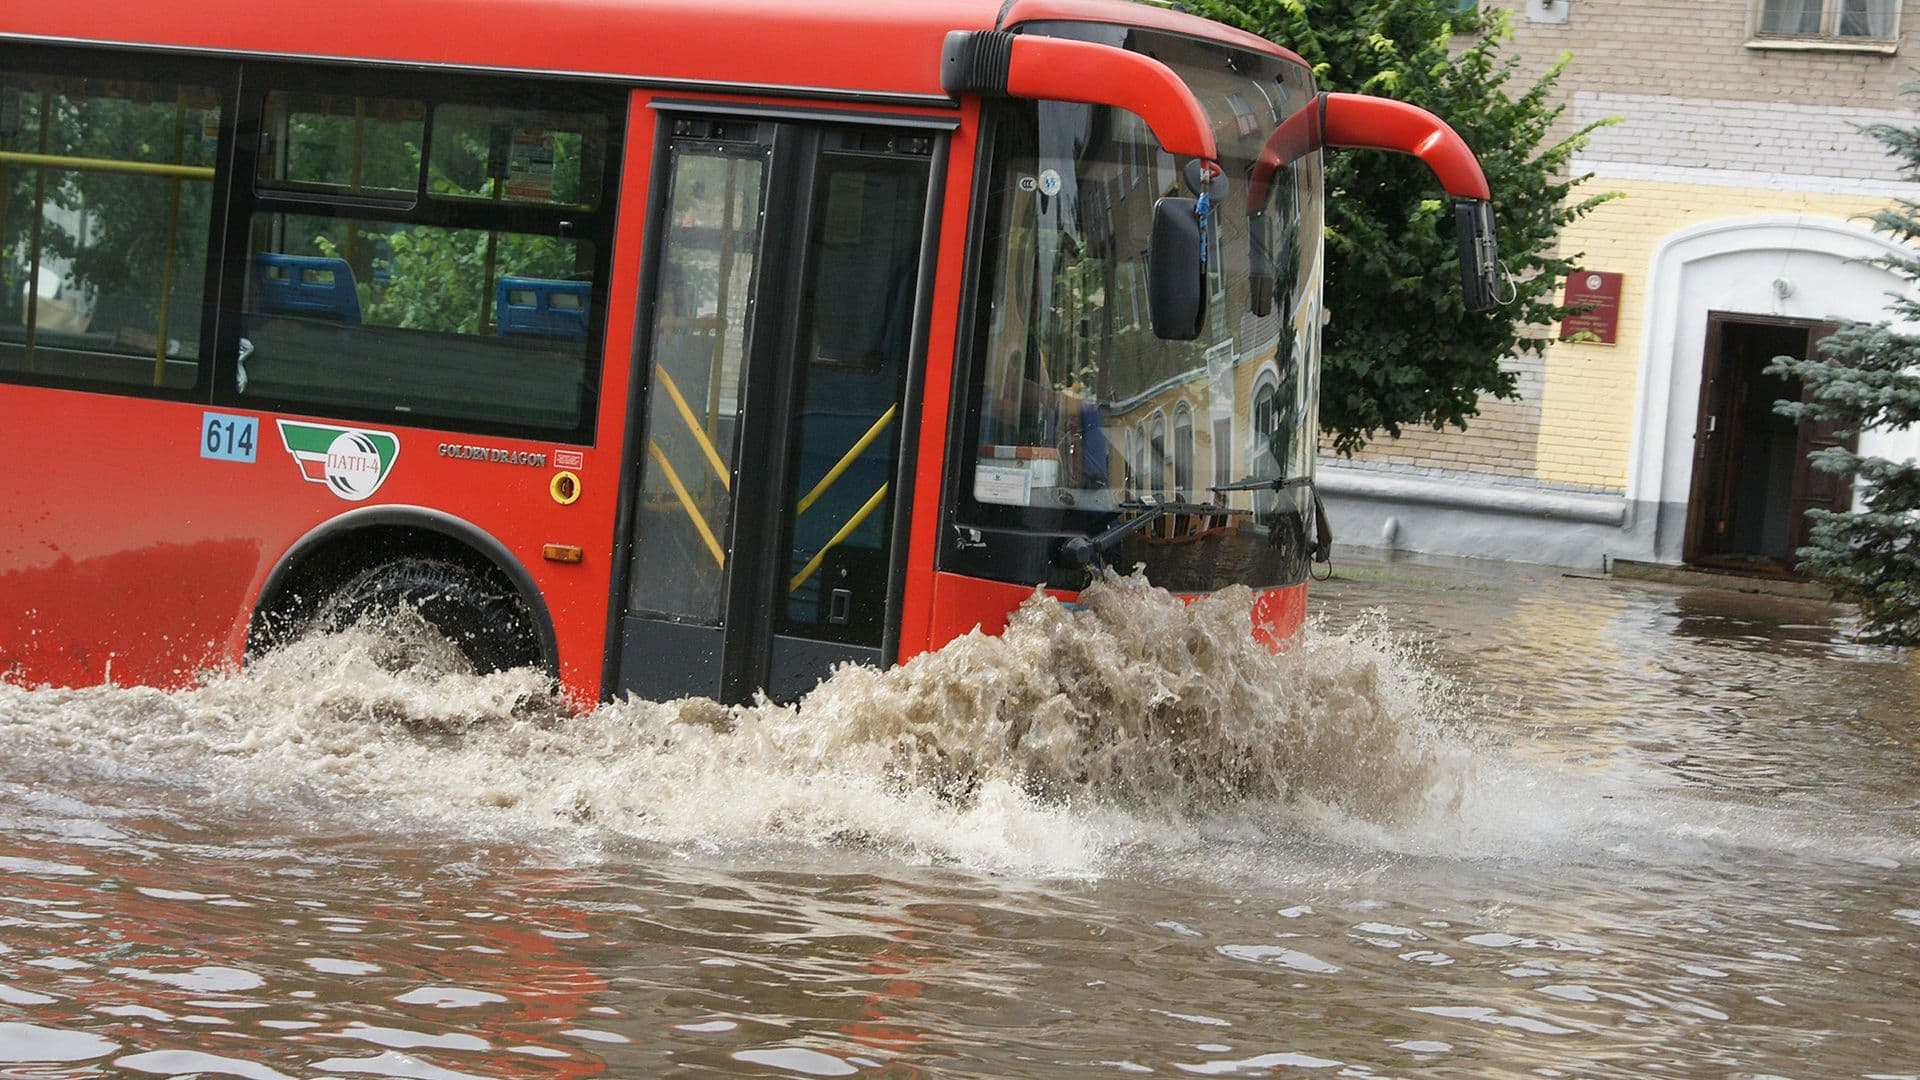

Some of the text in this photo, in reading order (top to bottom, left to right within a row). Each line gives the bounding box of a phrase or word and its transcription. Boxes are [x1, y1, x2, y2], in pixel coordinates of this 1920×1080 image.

[207, 419, 253, 456] 614
[327, 453, 379, 473] ПАТП-4
[438, 443, 490, 461] GOLDEN
[491, 449, 547, 467] DRAGON
